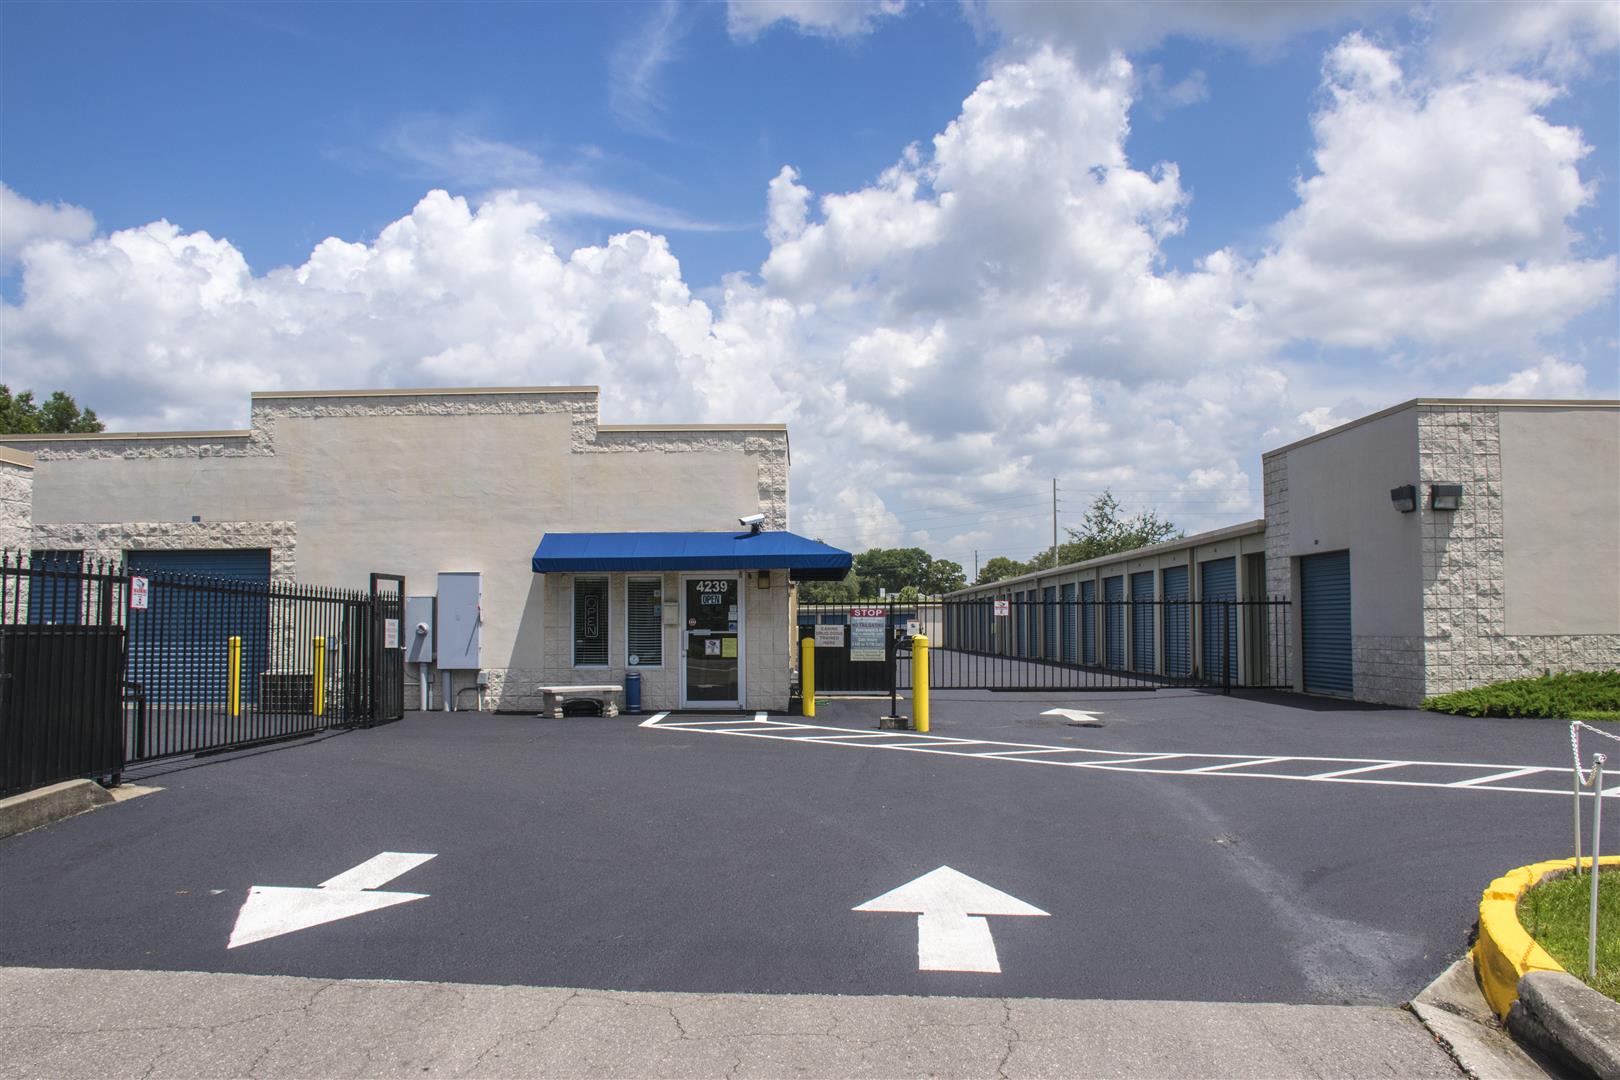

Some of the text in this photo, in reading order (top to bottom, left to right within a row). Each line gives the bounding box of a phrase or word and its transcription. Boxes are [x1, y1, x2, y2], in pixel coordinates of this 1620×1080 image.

[696, 580, 728, 592] 4239
[702, 595, 721, 604] OPEN
[586, 598, 597, 635] OPEN
[854, 609, 882, 617] STOP
